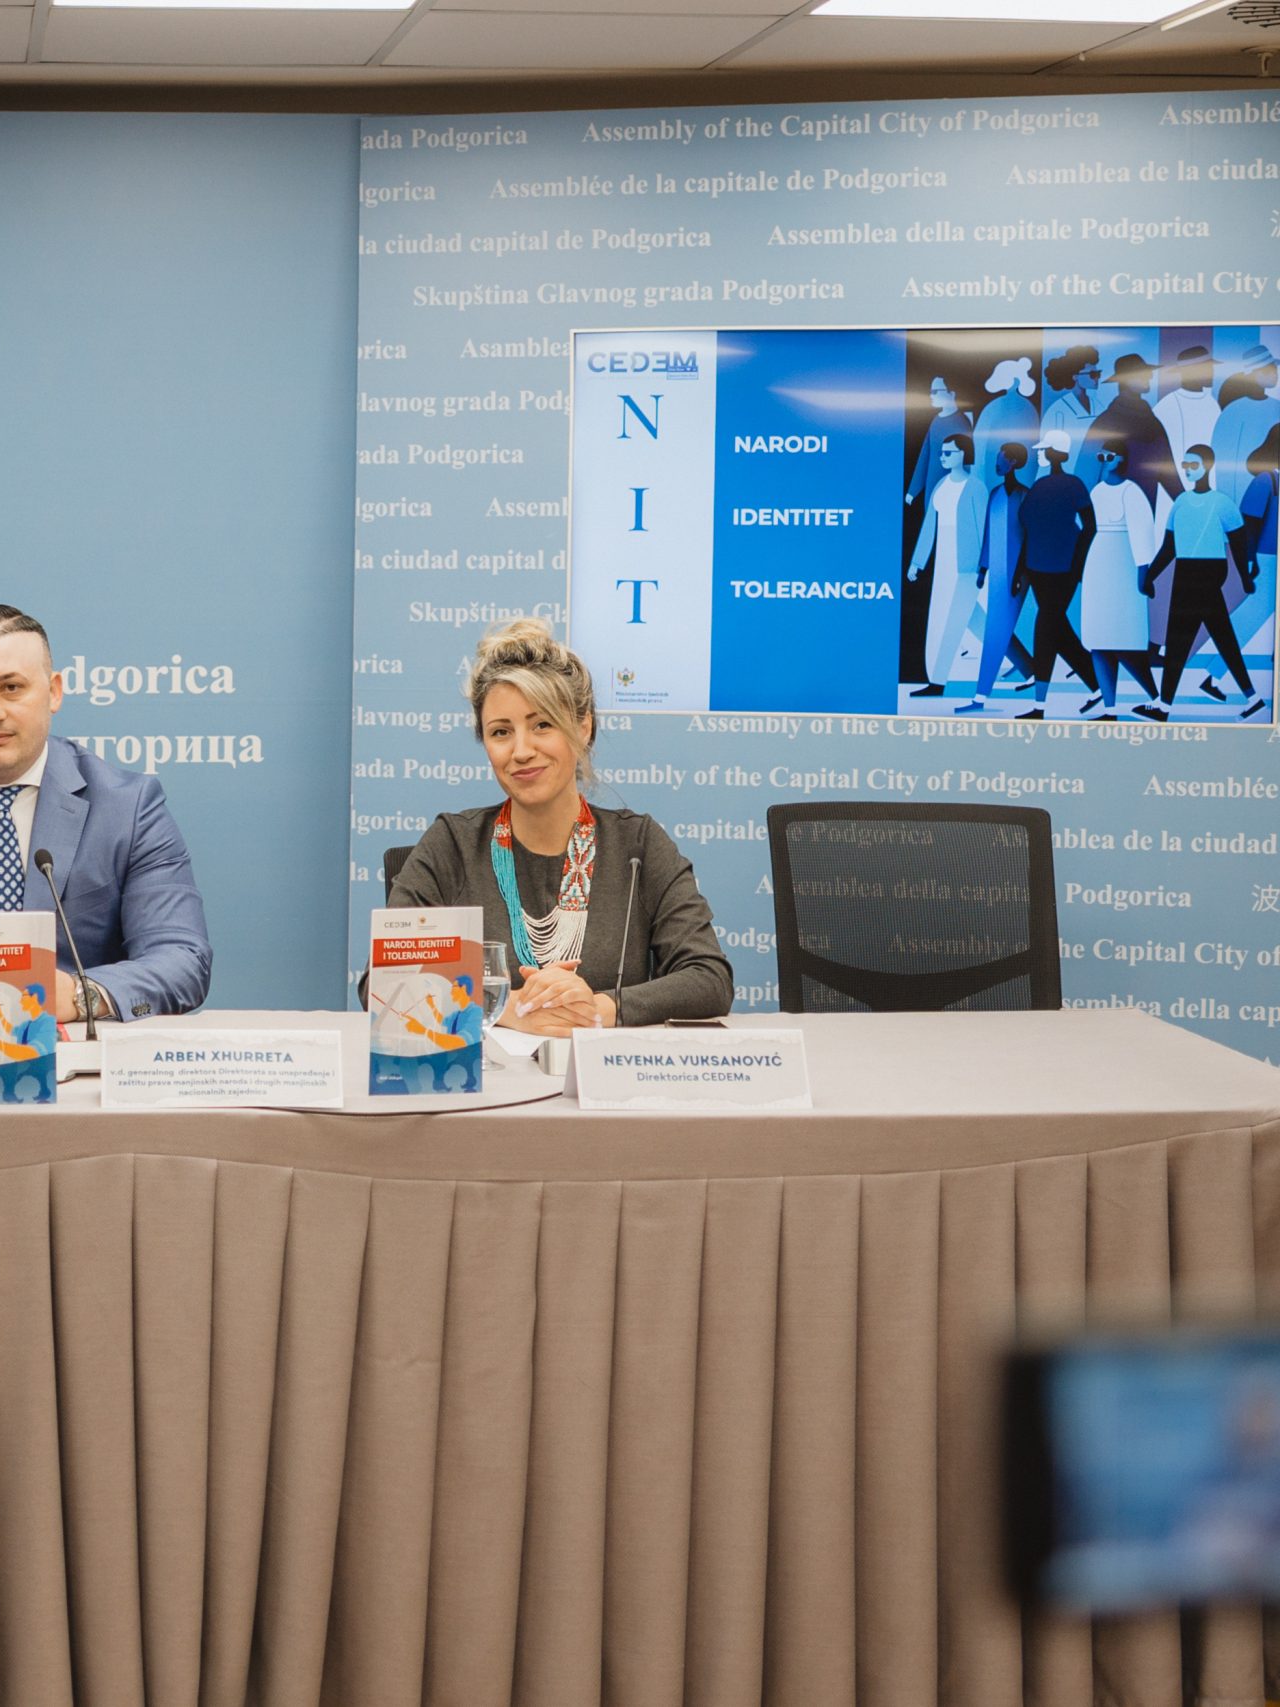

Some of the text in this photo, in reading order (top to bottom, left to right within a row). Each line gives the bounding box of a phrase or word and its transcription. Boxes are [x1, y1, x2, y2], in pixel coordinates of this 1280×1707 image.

[582, 107, 1099, 144] Assembly of the Capital City of Podgorica
[490, 167, 946, 199] Assemblée de la capitale de Podgorica
[1006, 160, 1200, 184] Asamblea de la
[359, 227, 711, 257] la ciudad capital de Podgorica
[768, 216, 1210, 246] Assemblea della capitale Podgorica
[414, 278, 844, 311] Skupština Glavnog grada Podgorica
[902, 272, 1268, 302] Assembly of the Capital City
[616, 394, 664, 440] N
[734, 435, 828, 453] NARODI
[629, 488, 650, 532] I
[732, 508, 854, 527] IDENTITET
[616, 580, 659, 624] T
[730, 580, 894, 600] TOLERANCIJA
[694, 765, 1084, 798] of the Capital City of Podgorica
[1144, 775, 1278, 799] Assemblée
[674, 819, 768, 844] capitale
[1066, 883, 1191, 911] Podgorica
[388, 951, 439, 960] TOLERANCIJA
[418, 939, 455, 948] IDENTITET
[1093, 939, 1280, 970] Capital City of
[153, 1051, 294, 1063] ARBEN XHURRETA
[604, 1051, 783, 1067] NEVENKA VUKSANOVIĆ
[127, 1068, 174, 1078] generalnog
[218, 1068, 266, 1076] Direktorata
[173, 1078, 217, 1087] manjinskih
[636, 1072, 751, 1082] Direktorica CEDEMa
